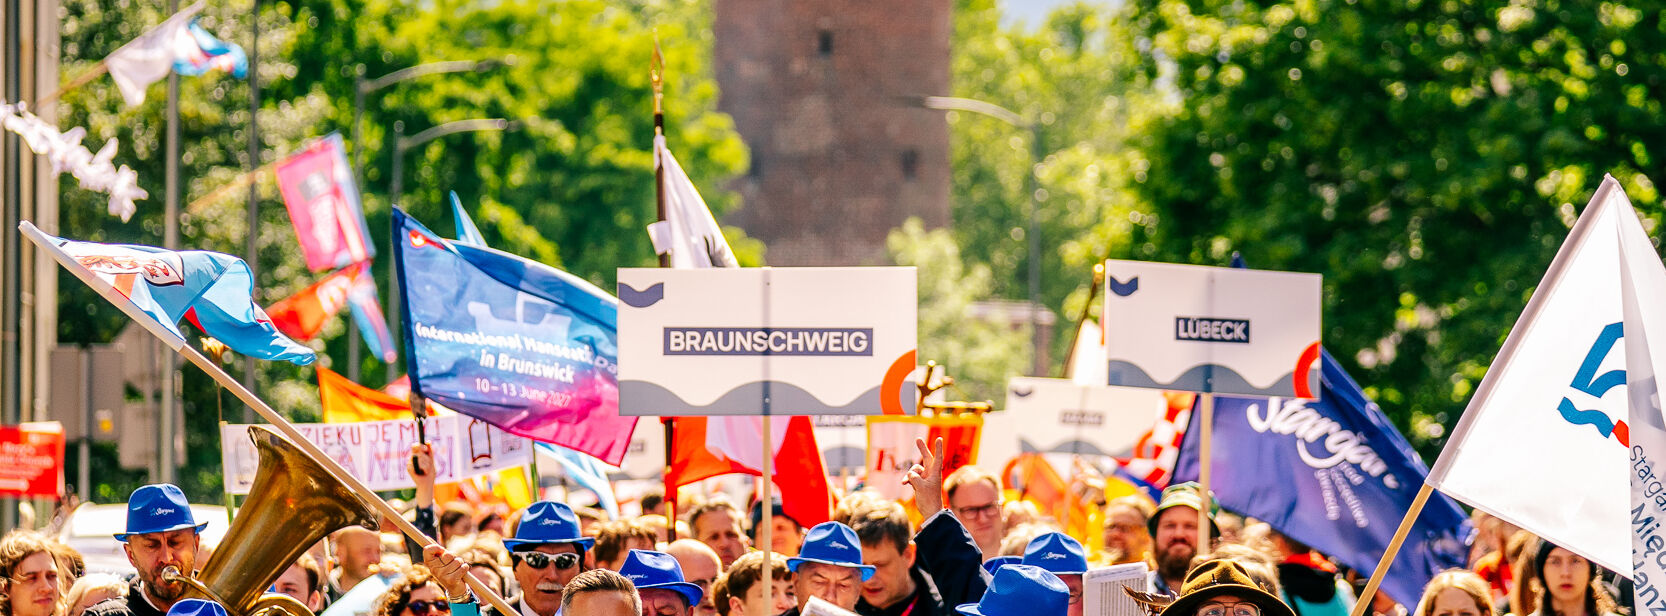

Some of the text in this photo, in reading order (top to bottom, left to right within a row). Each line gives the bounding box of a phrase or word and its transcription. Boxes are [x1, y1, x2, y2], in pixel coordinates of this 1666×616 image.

[668, 330, 869, 352] BRAUNSCHWEIG
[1178, 317, 1247, 340] LÜBECK
[415, 321, 521, 350] International
[524, 335, 594, 364] Hanseati
[479, 348, 576, 384] in Brunswick
[475, 377, 490, 393] 10
[501, 382, 518, 397] 13
[519, 384, 549, 402] June
